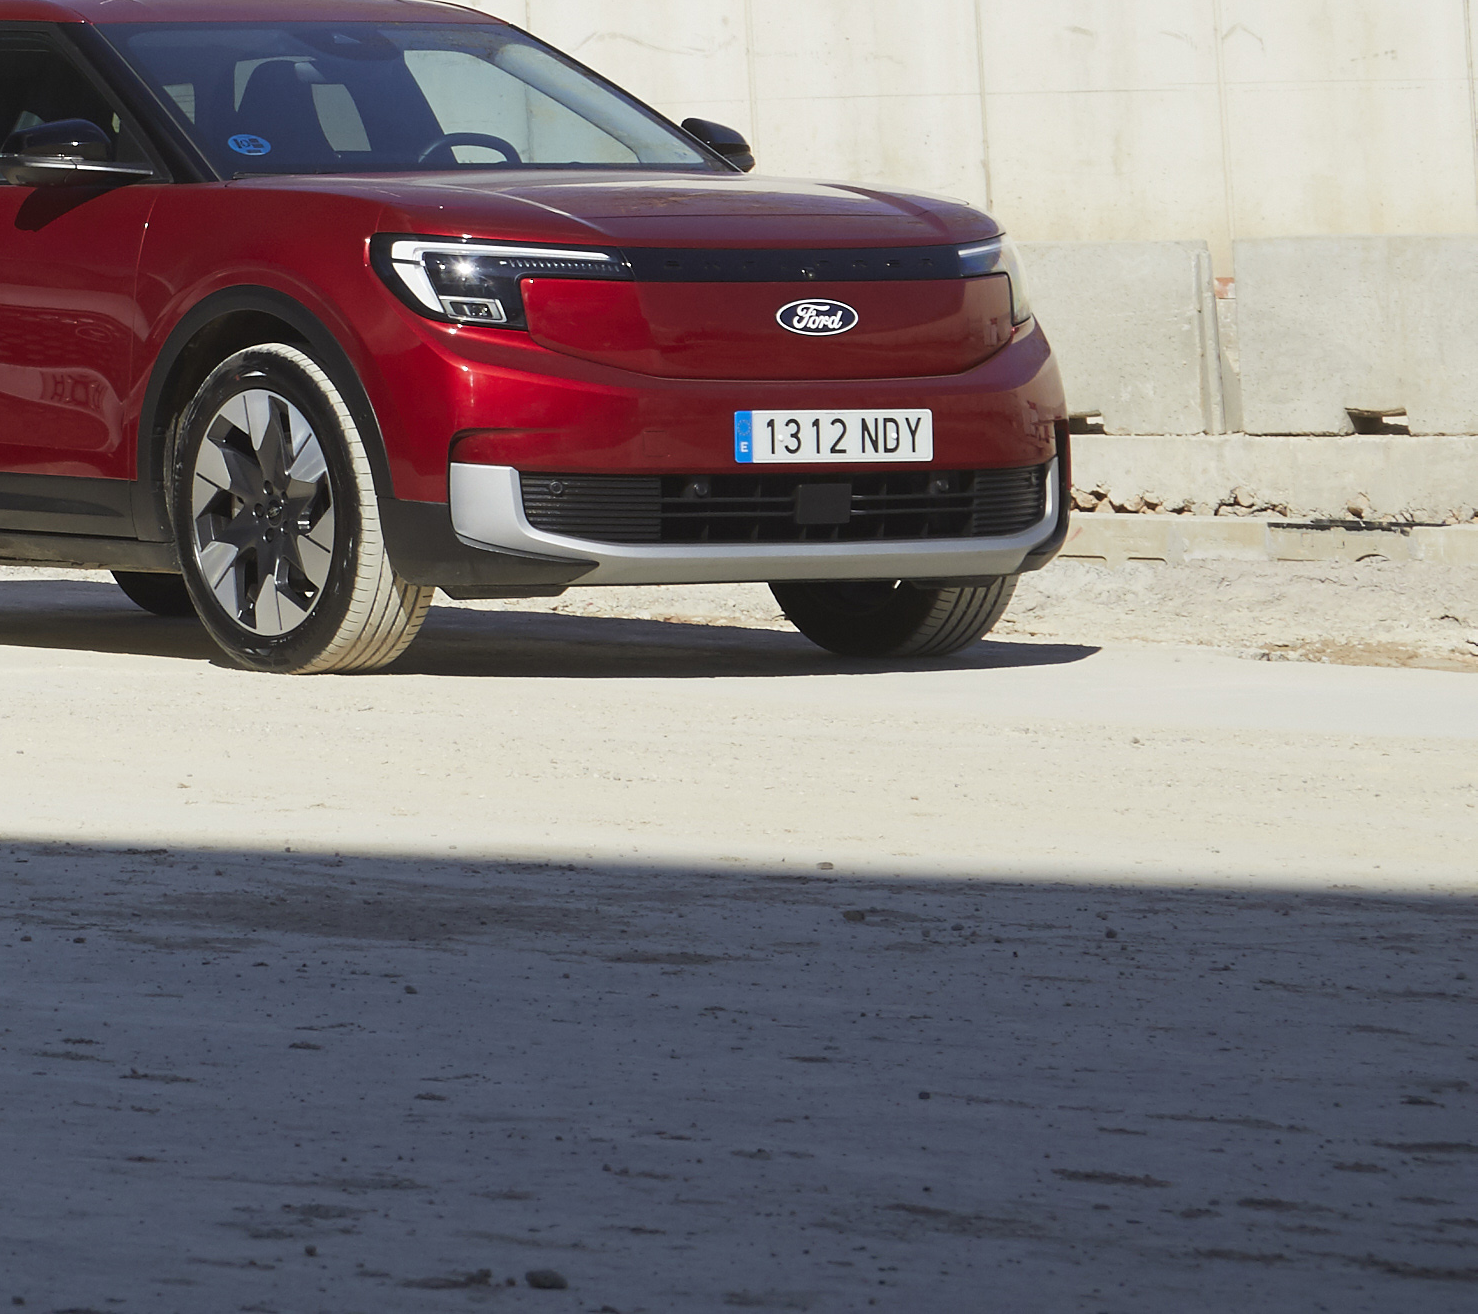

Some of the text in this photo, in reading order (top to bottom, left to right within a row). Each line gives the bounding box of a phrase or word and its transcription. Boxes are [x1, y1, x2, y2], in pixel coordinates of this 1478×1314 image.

[790, 302, 846, 331] Ford
[740, 417, 922, 455] E 1312 NDY
